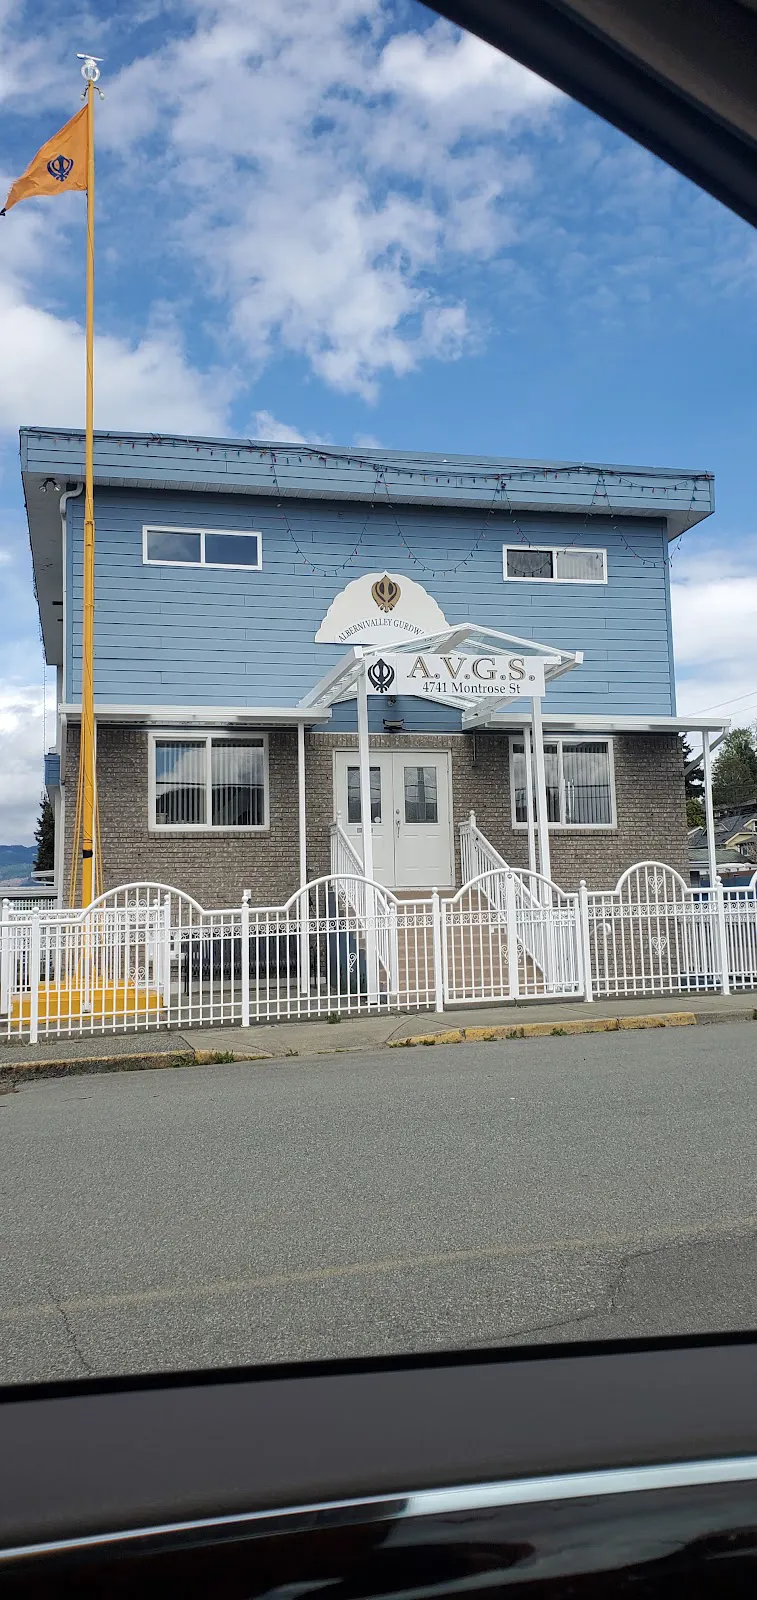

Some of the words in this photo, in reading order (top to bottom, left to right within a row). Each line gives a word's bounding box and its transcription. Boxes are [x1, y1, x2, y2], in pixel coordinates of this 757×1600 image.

[406, 655, 536, 682] A.V.G.S.
[422, 681, 447, 693] 4741
[451, 682, 506, 694] Montrose
[508, 683, 521, 694] St
